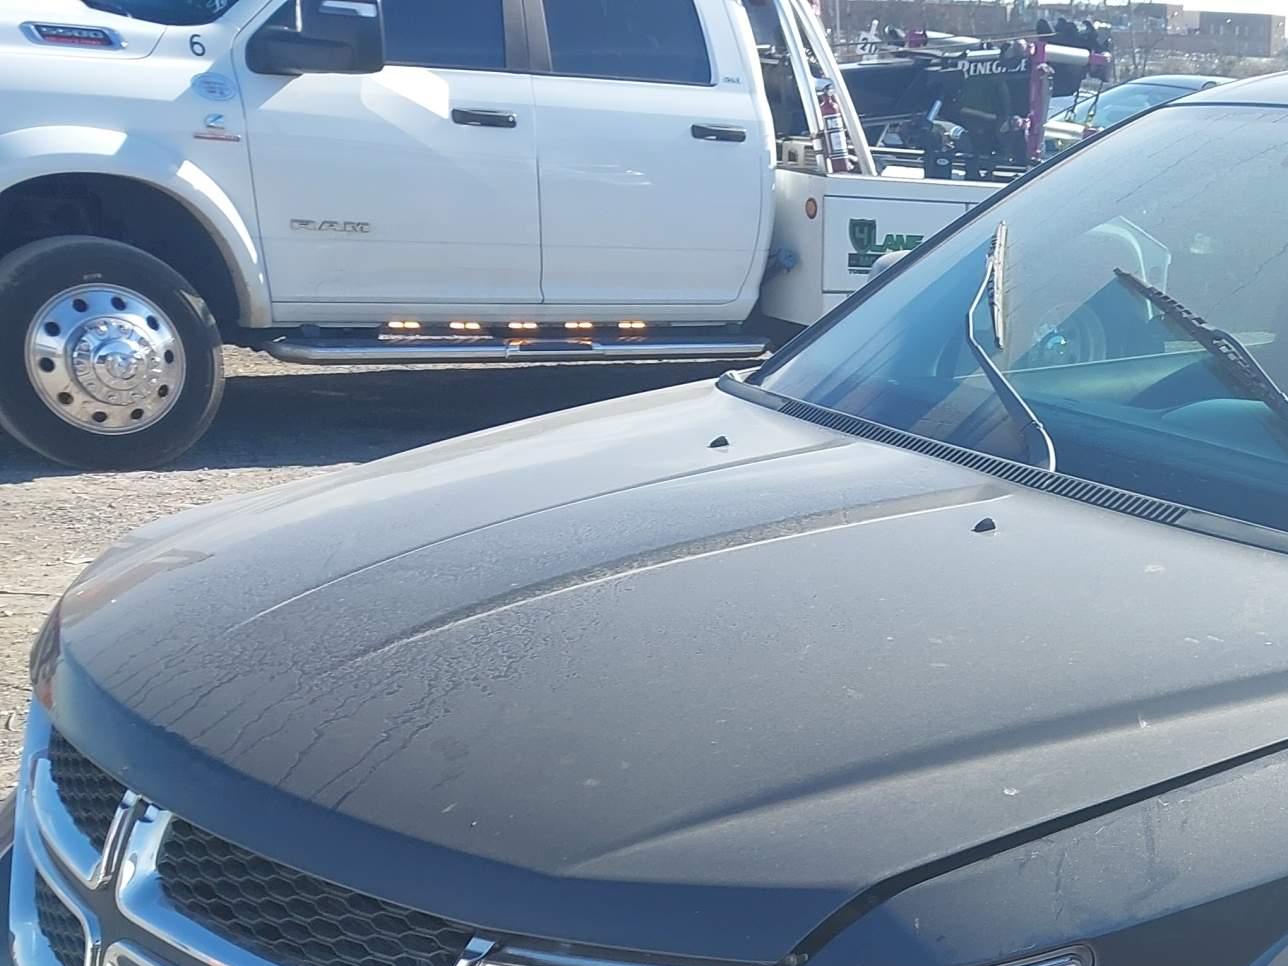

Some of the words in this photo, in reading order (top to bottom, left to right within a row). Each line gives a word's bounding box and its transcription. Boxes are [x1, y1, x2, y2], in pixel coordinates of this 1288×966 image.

[189, 34, 206, 57] 6
[957, 59, 1028, 79] RENEGE
[289, 218, 370, 234] RAM
